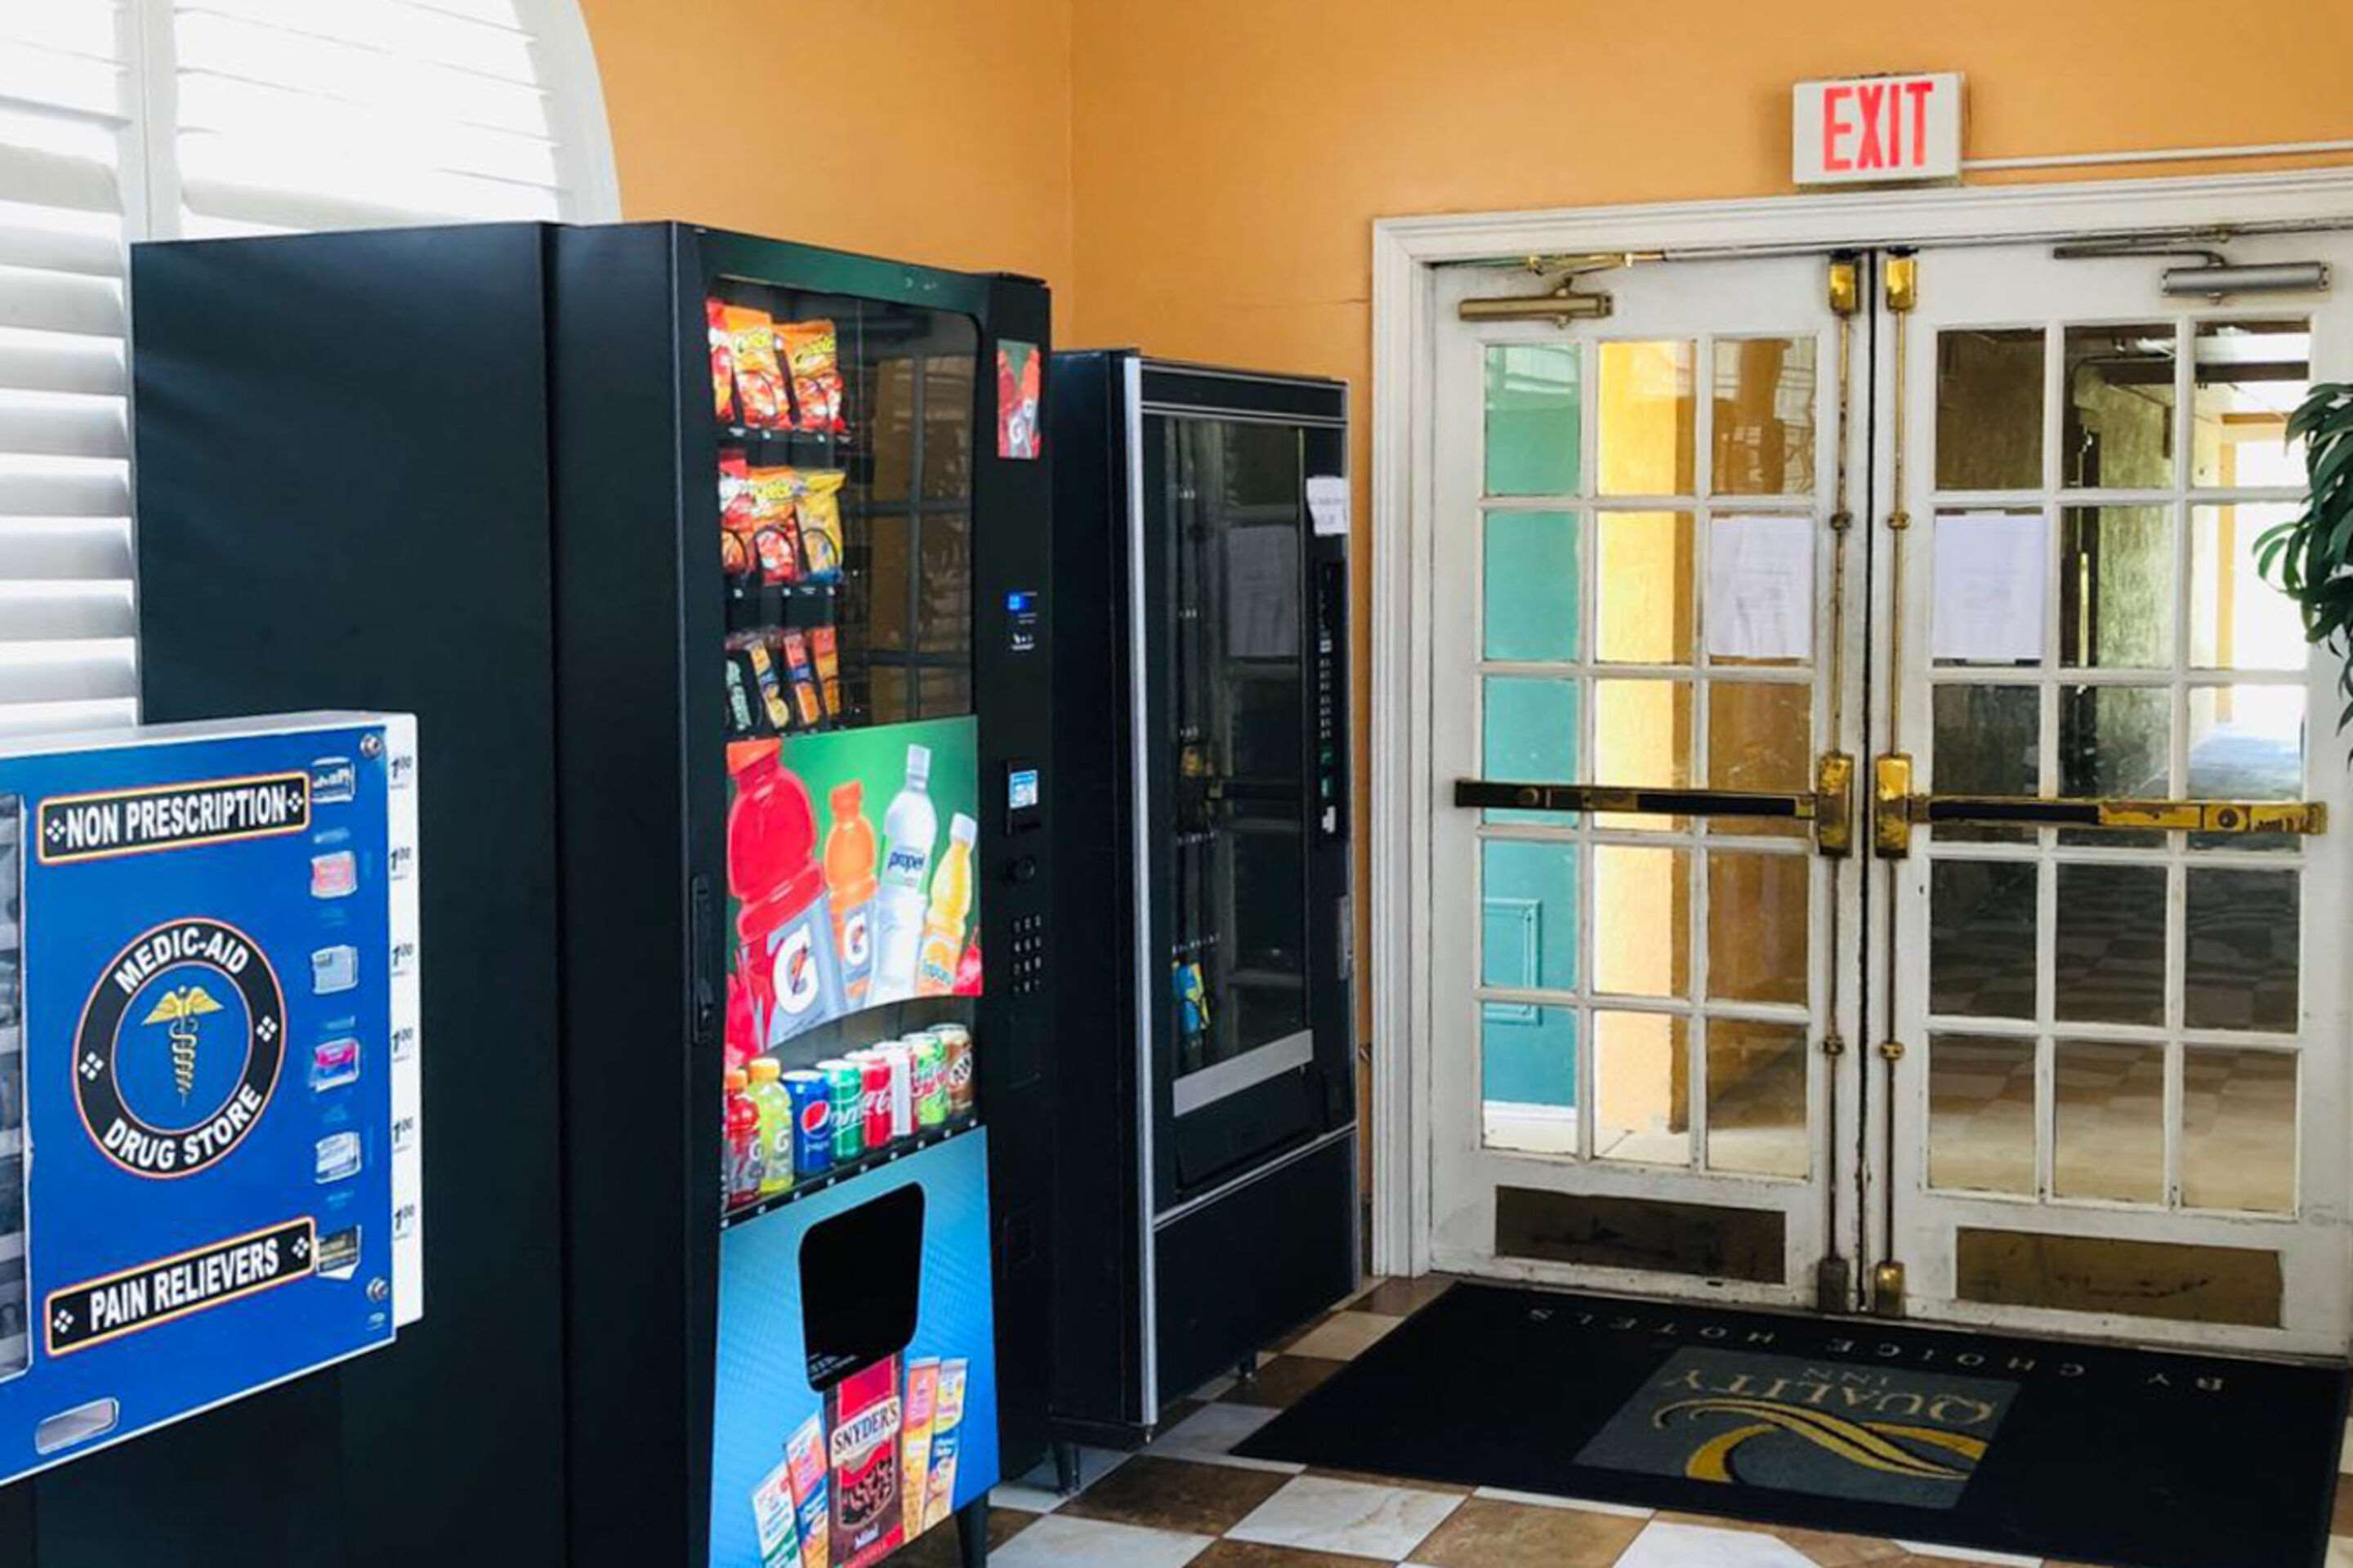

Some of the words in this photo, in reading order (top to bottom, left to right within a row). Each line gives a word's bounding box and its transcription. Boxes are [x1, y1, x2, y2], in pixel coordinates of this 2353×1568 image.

[1824, 82, 1934, 171] EXIT
[66, 805, 118, 848] NON
[126, 785, 287, 841] PRESCRIPTION
[887, 851, 925, 872] propel
[114, 927, 249, 994] MEDIC-AID
[773, 922, 819, 1014] G
[844, 913, 868, 967] G
[102, 1118, 176, 1169] DRUG
[184, 1083, 264, 1166] STORE
[90, 1282, 148, 1331] PAIN
[154, 1239, 279, 1312] RELIEVERS
[1529, 1307, 1775, 1344] HOTELS
[1803, 1366, 1889, 1387] INN
[1826, 1338, 2086, 1378] CHOICE
[1663, 1369, 1998, 1425] QUALITY
